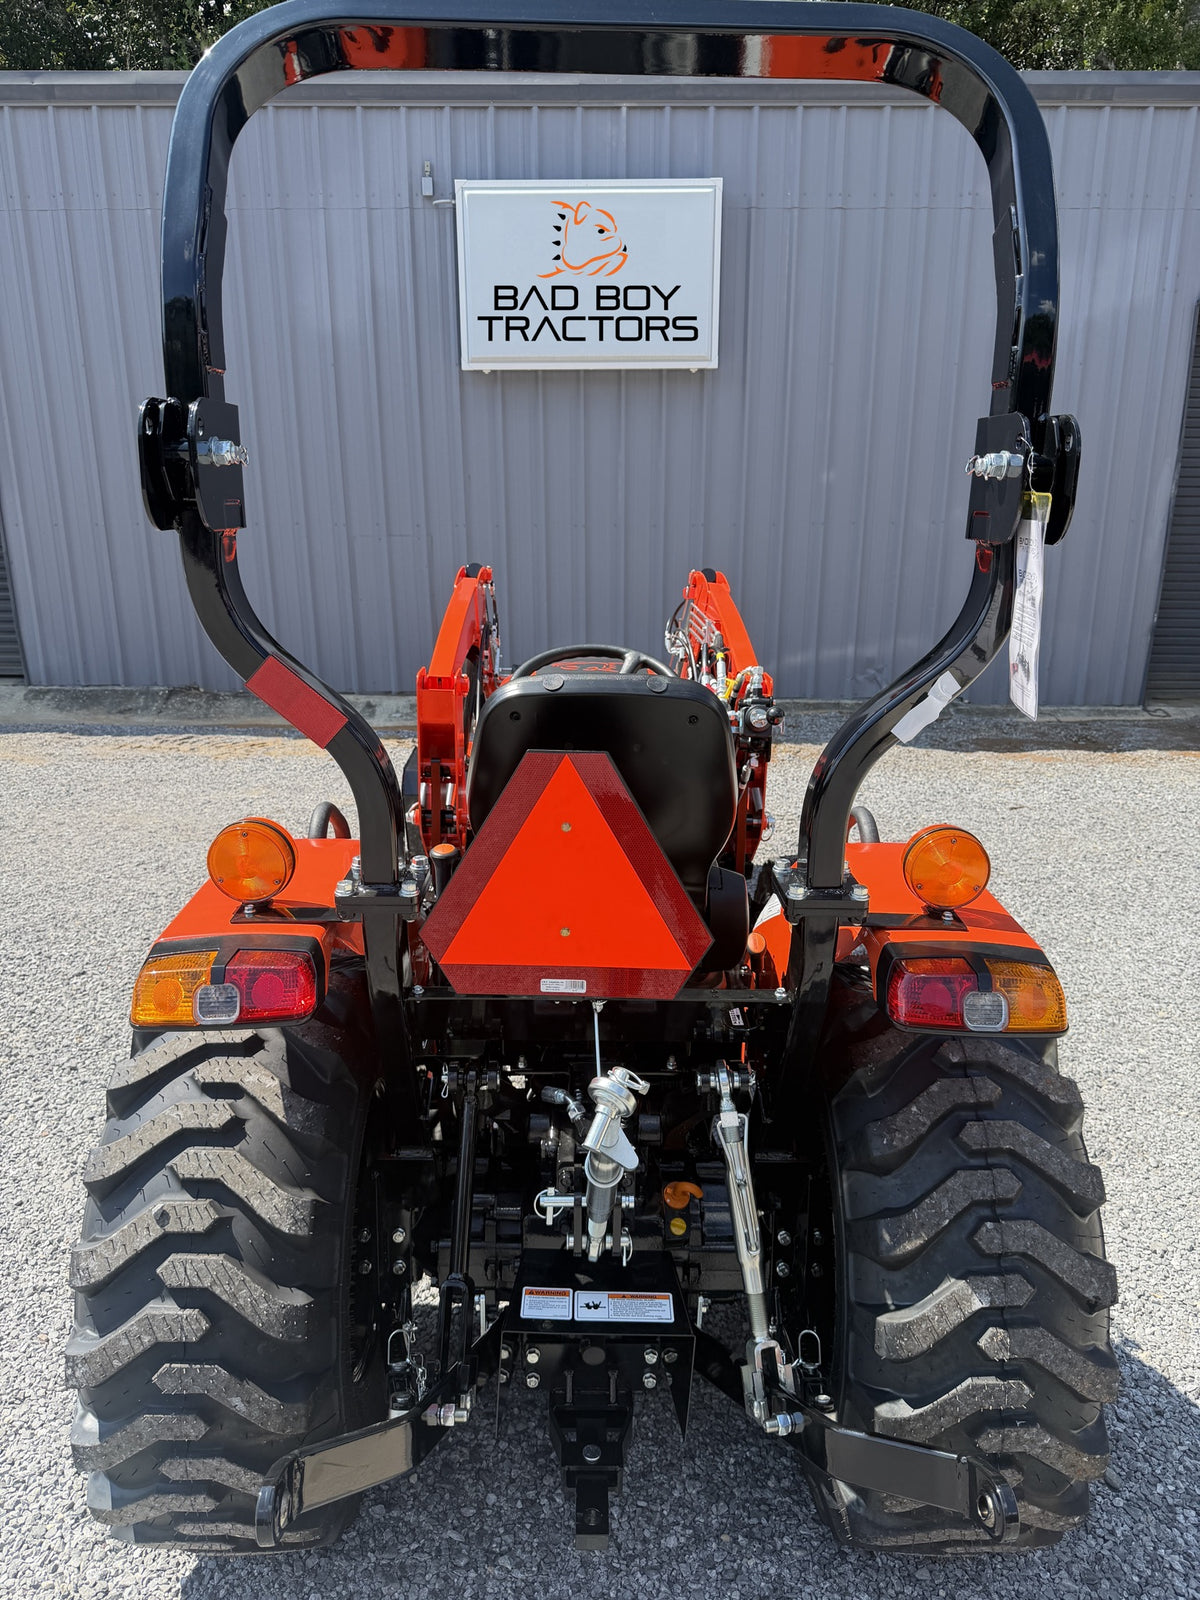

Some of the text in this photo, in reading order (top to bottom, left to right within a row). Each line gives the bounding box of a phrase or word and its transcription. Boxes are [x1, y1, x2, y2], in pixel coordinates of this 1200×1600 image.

[493, 285, 682, 311] BAD BOY
[477, 315, 699, 342] TRACTORS
